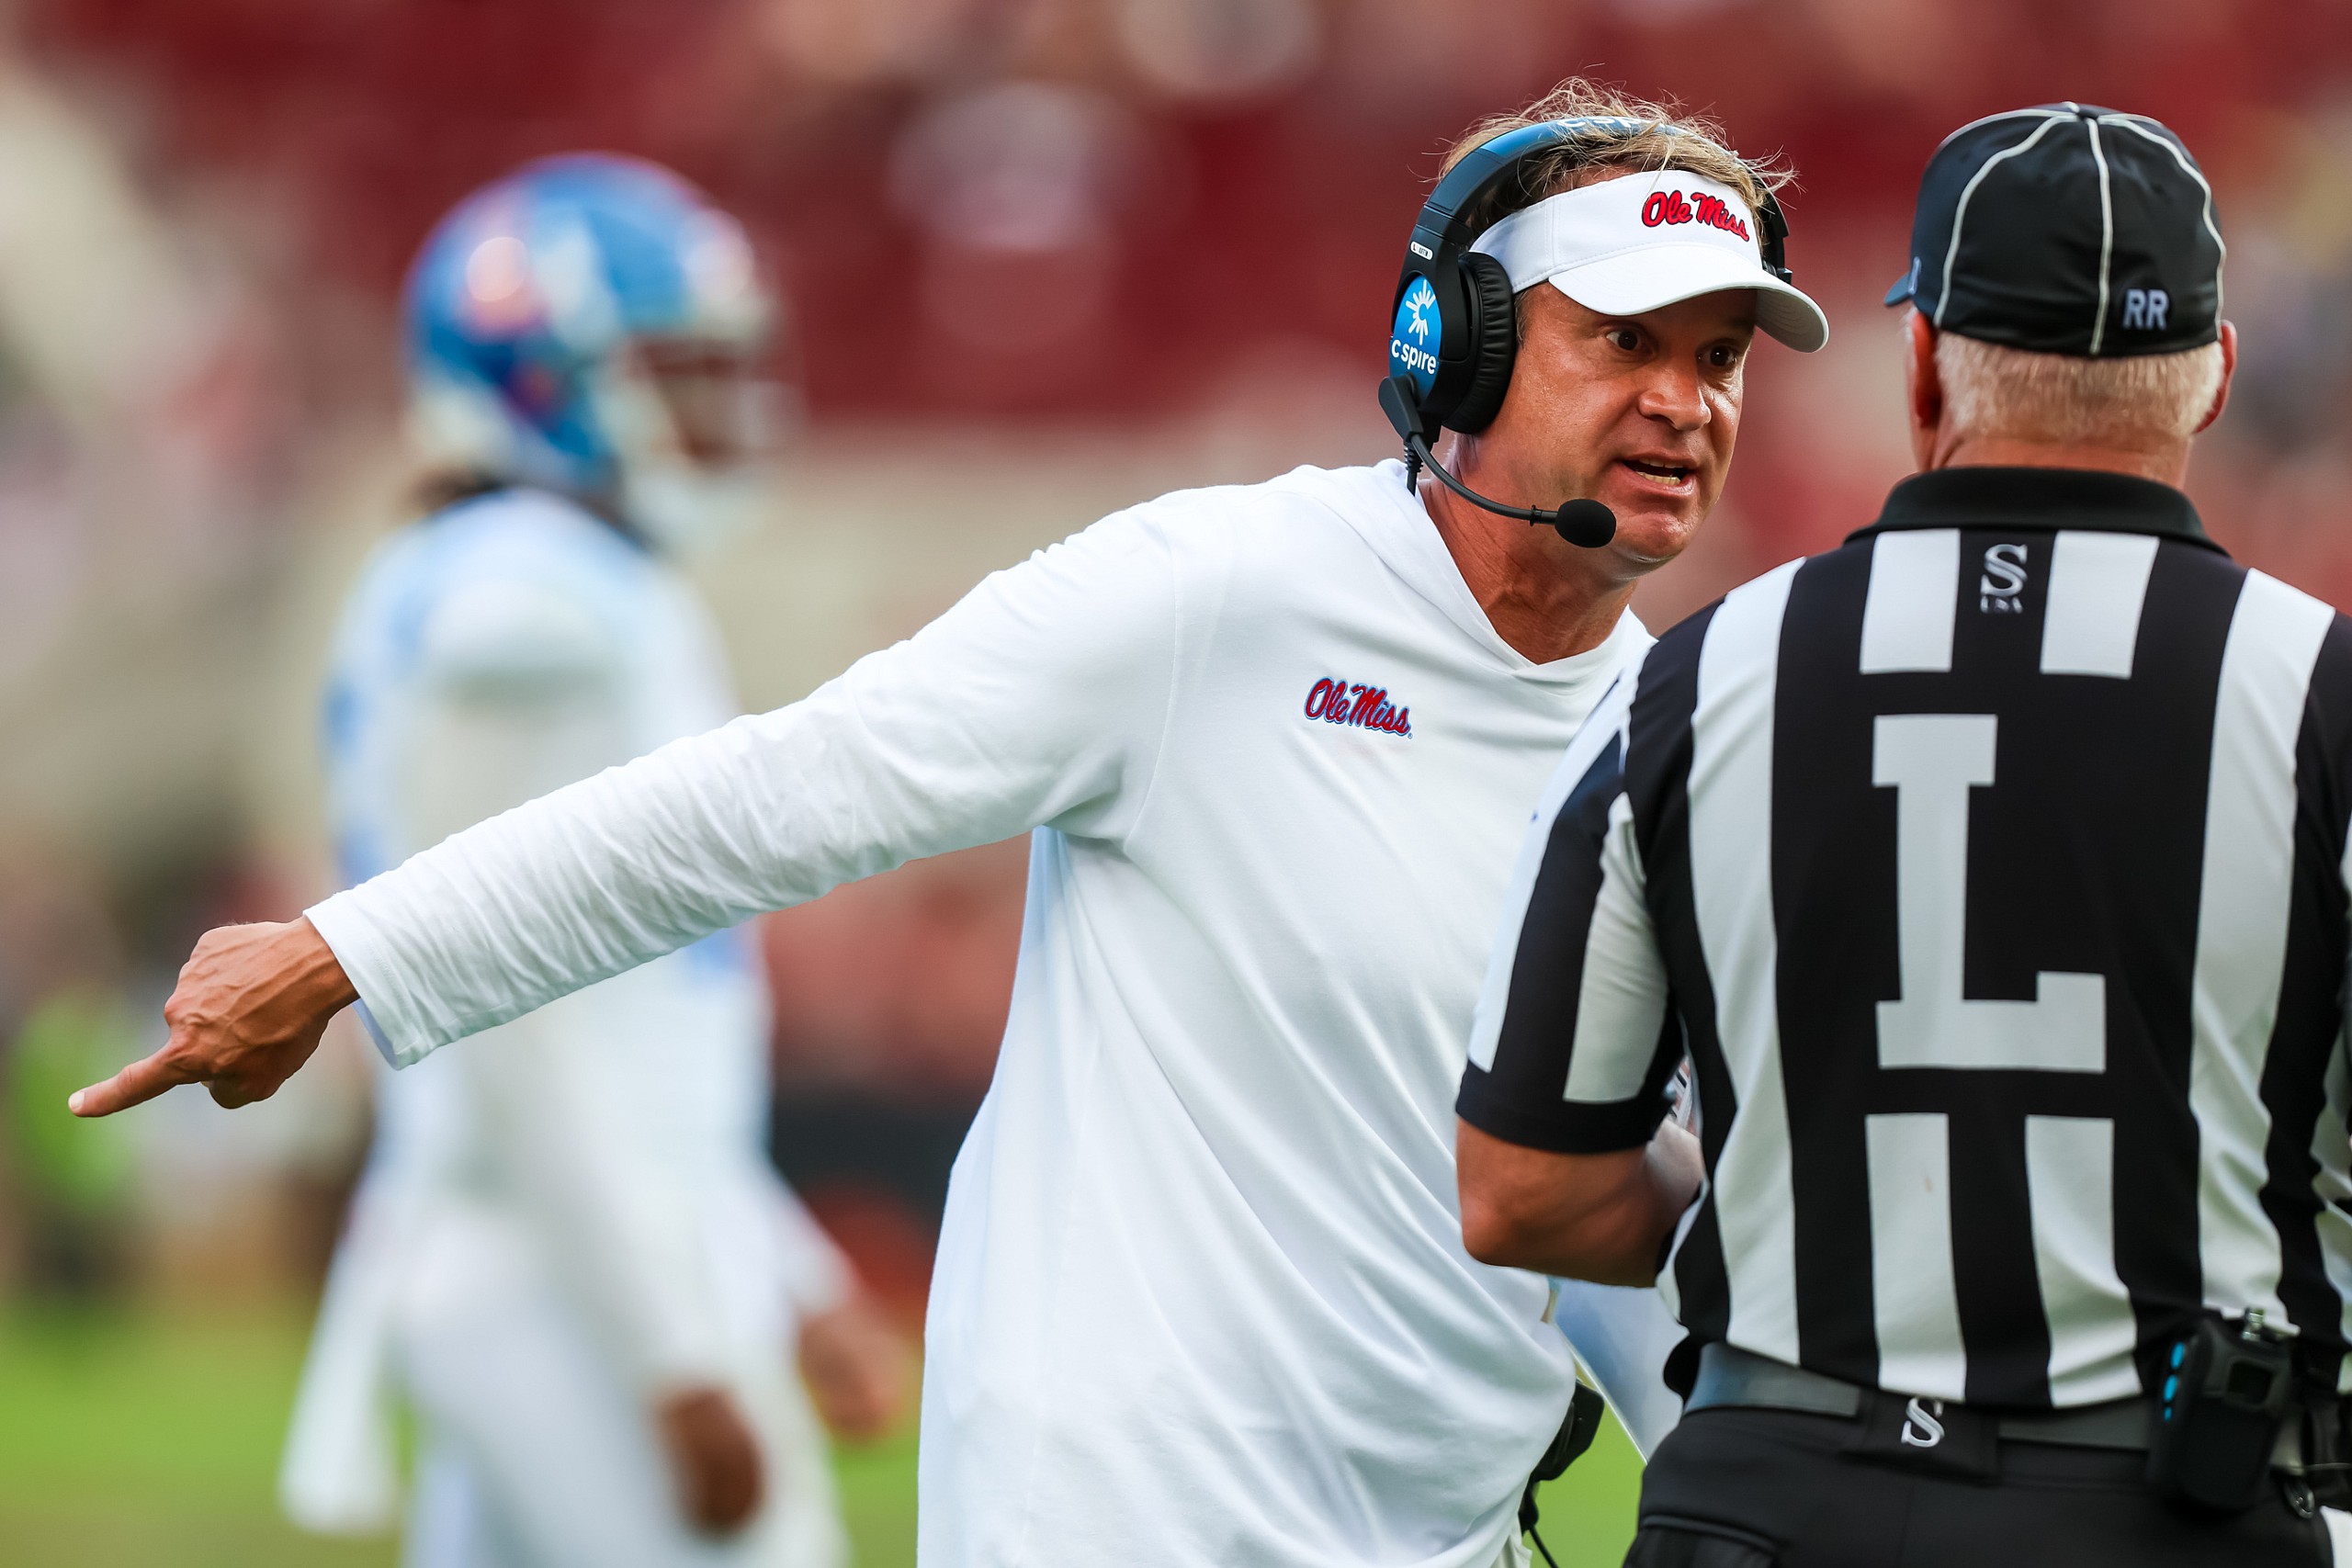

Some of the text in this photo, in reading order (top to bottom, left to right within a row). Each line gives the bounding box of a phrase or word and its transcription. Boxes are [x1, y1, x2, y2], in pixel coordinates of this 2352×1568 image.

[1642, 189, 1750, 243] Ole Miss
[2123, 288, 2169, 330] RR
[1401, 343, 1437, 375] spire
[1305, 677, 1411, 737] Ole Miss
[1872, 713, 2107, 1075] L
[1900, 1395, 1945, 1449] S
